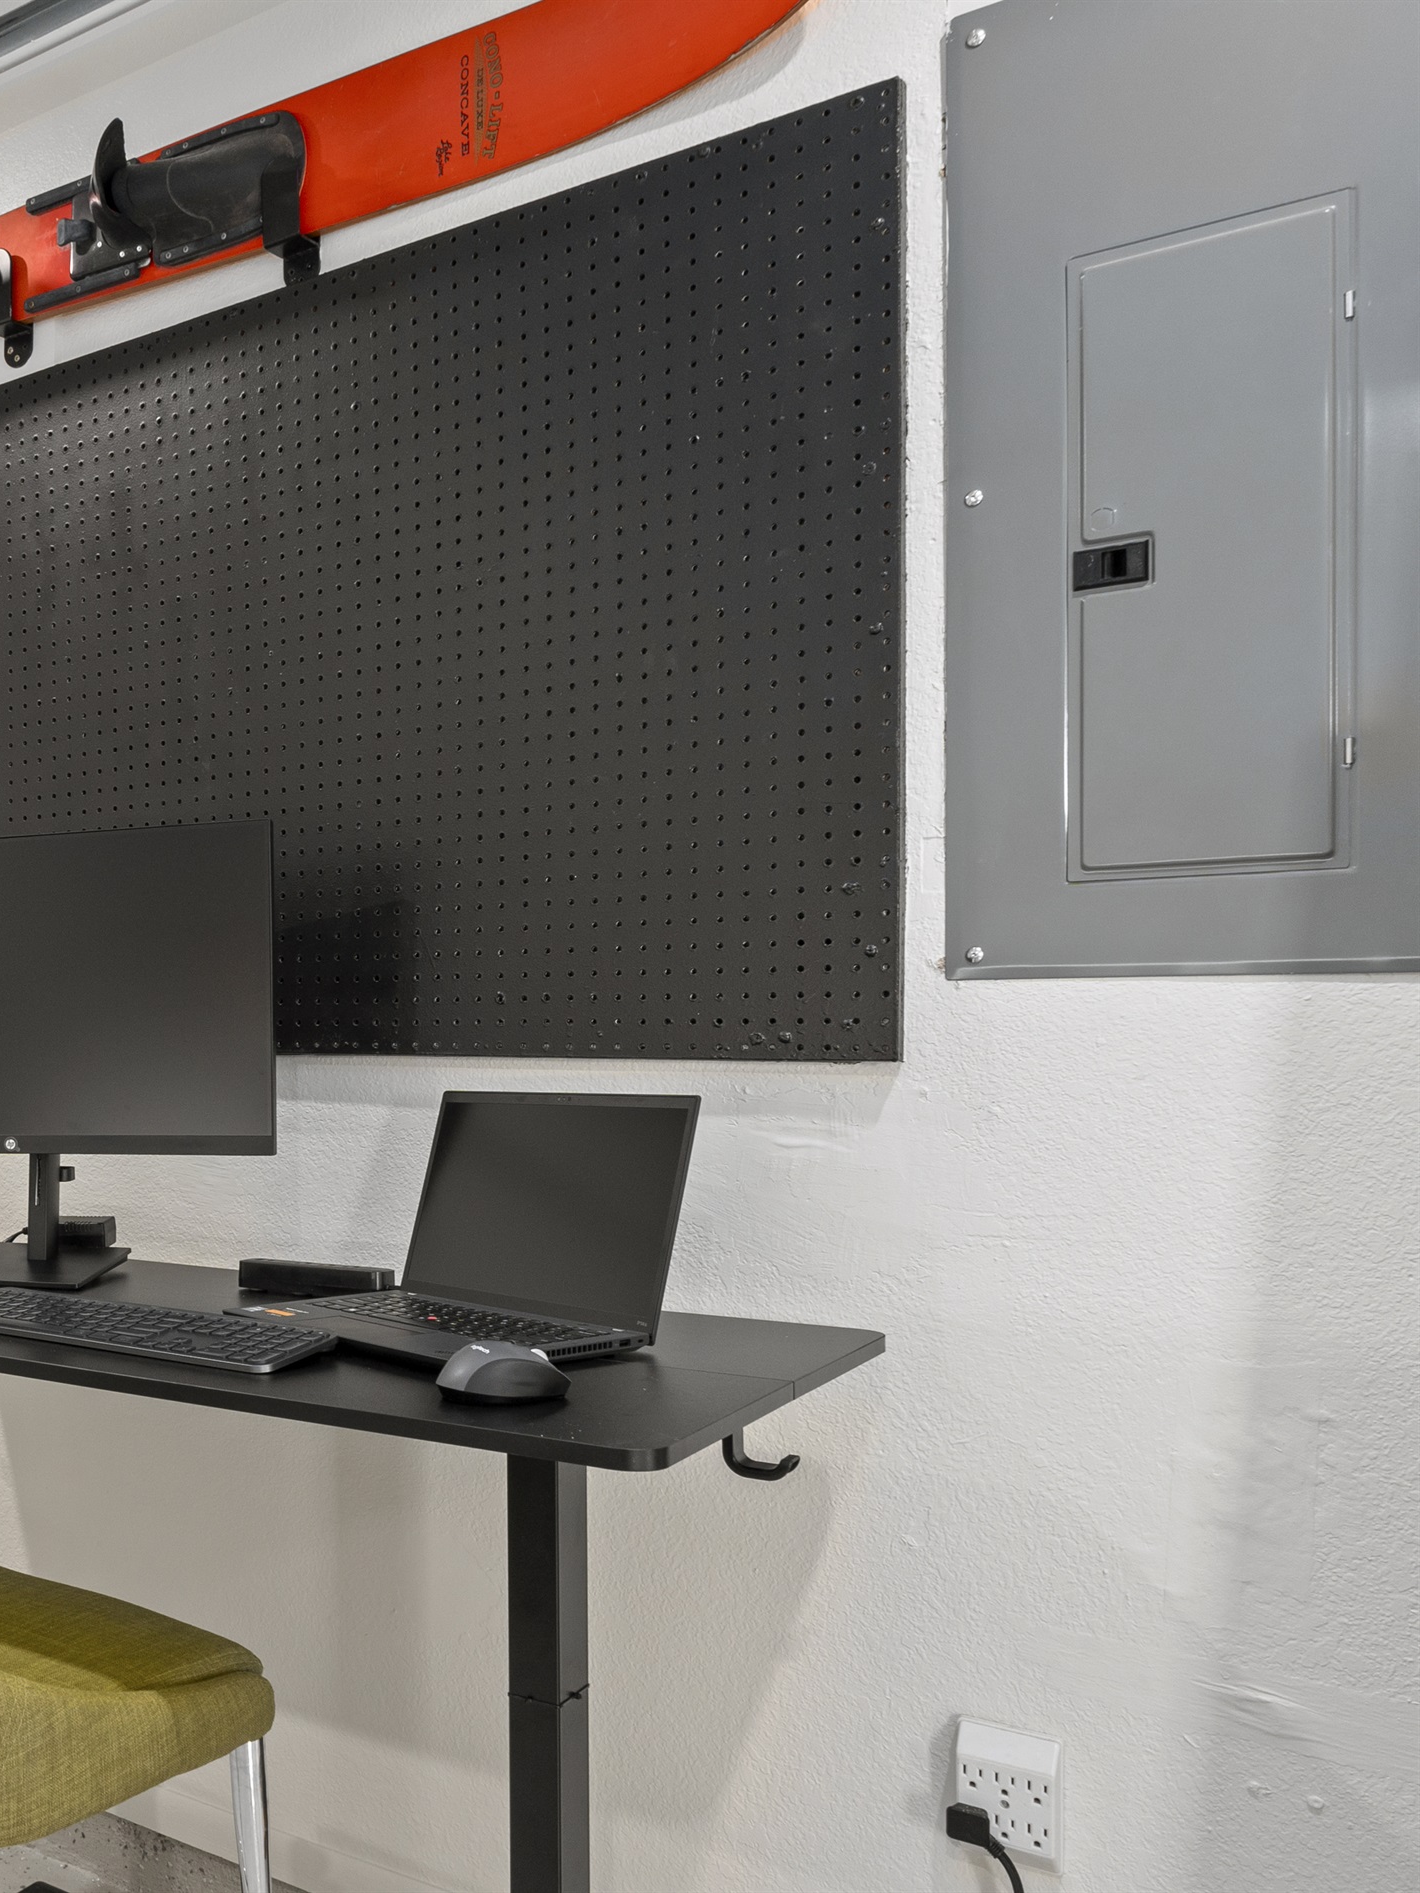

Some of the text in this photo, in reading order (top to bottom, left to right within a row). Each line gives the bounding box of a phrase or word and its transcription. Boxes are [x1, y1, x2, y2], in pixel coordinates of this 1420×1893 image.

[460, 55, 469, 156] CONCAVE
[476, 68, 484, 130] DE LUXE
